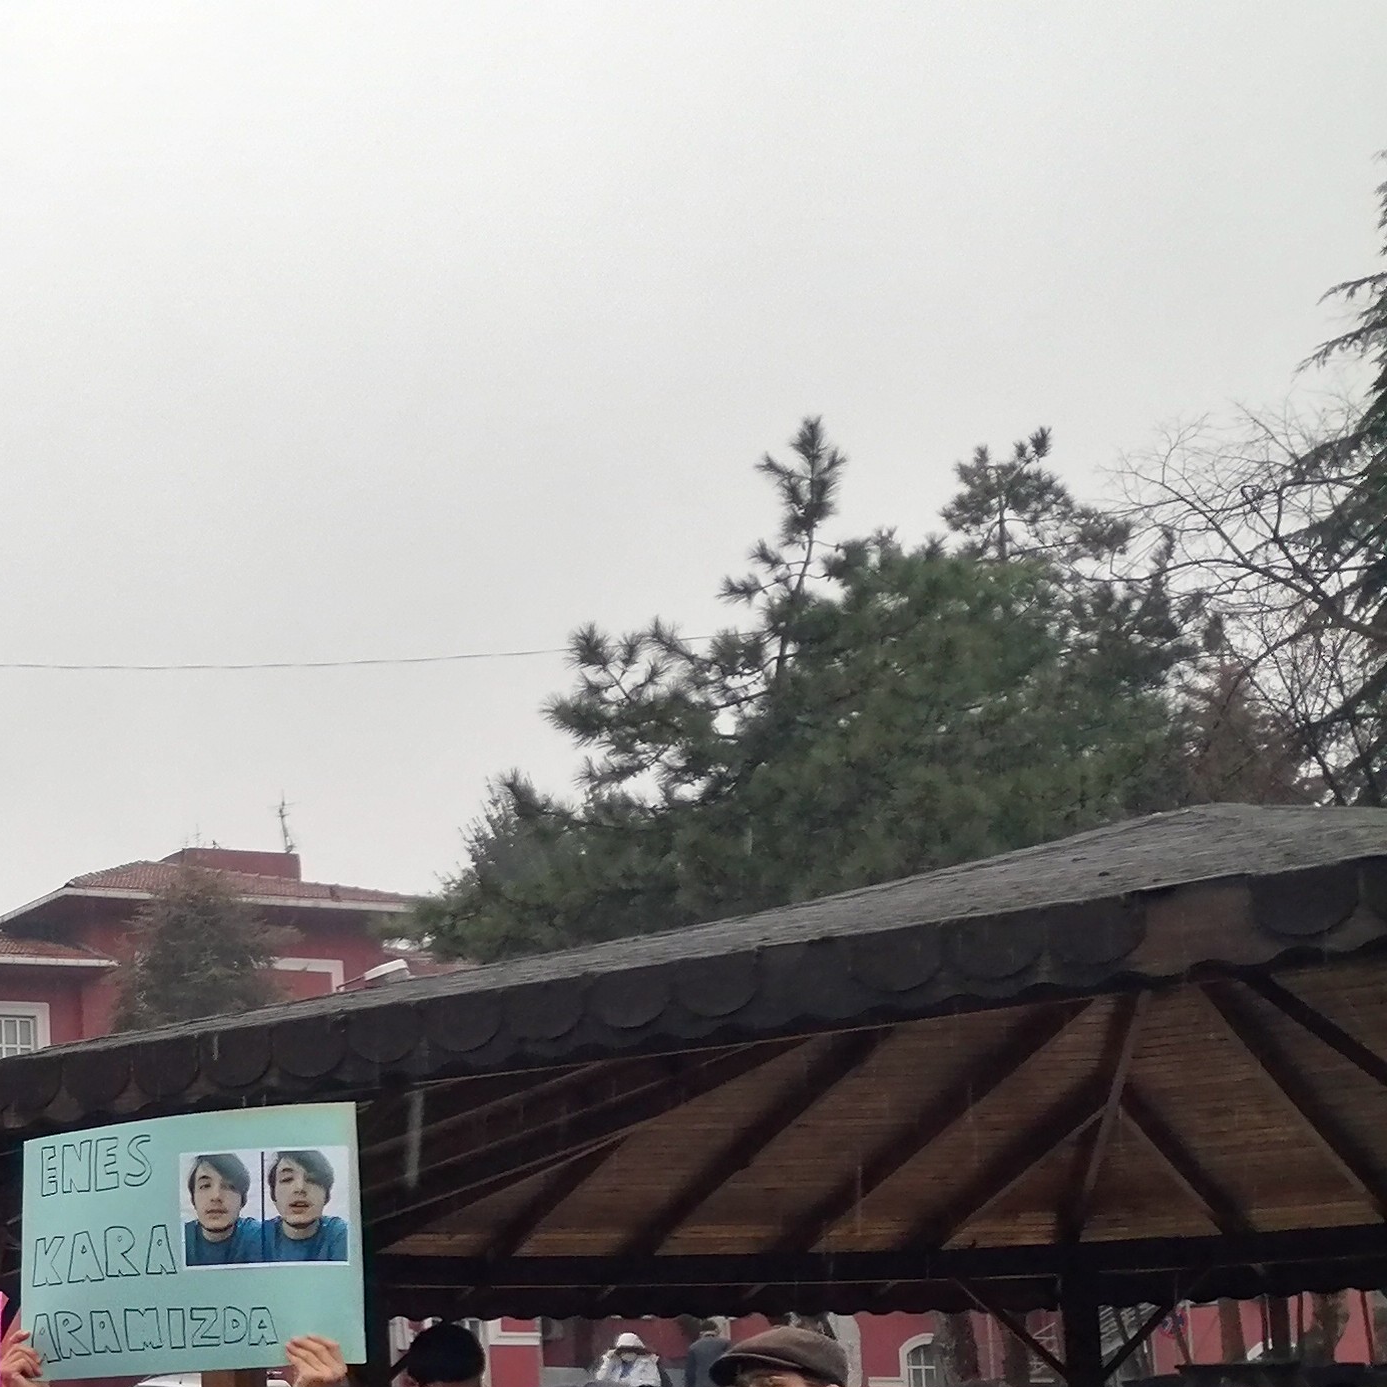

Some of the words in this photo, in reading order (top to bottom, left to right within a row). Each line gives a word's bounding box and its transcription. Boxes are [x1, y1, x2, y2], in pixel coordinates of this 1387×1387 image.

[40, 1134, 152, 1197] ENES
[32, 1224, 177, 1287] KARA
[30, 1305, 279, 1364] ARAMIZDA
